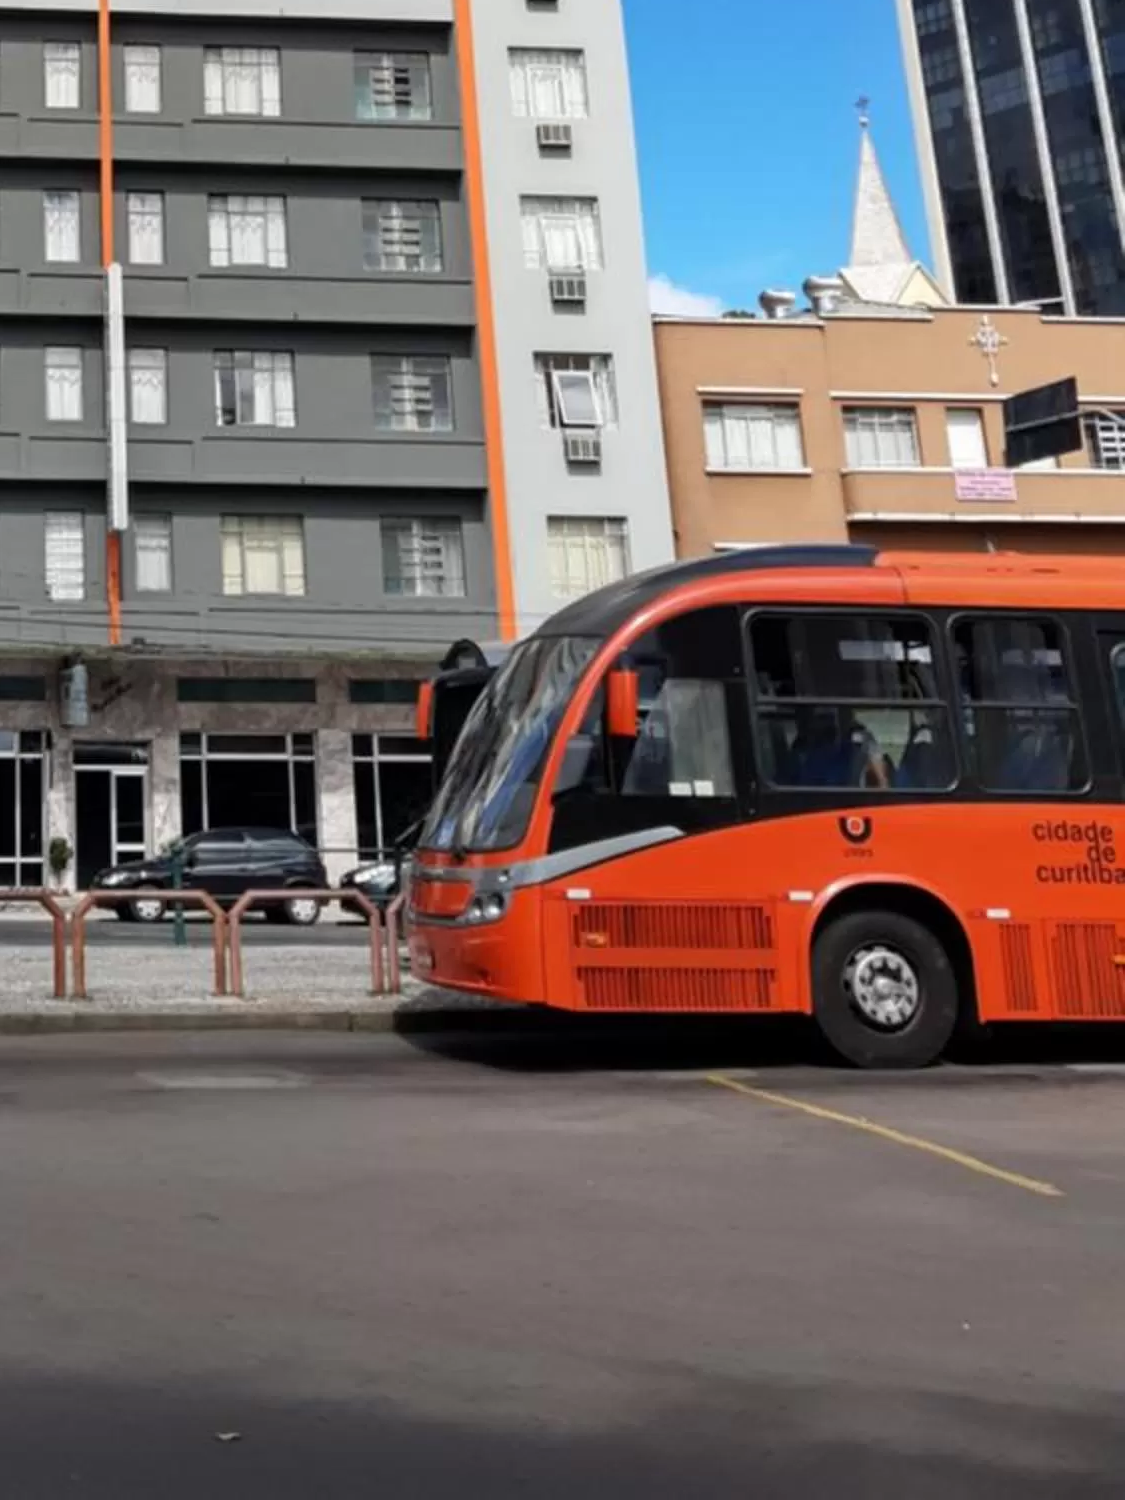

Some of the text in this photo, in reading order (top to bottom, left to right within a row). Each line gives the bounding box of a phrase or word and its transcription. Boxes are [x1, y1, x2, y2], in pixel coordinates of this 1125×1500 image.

[1032, 819, 1113, 842] cidade
[1086, 844, 1116, 864] de
[1036, 863, 1125, 884] curitiba
